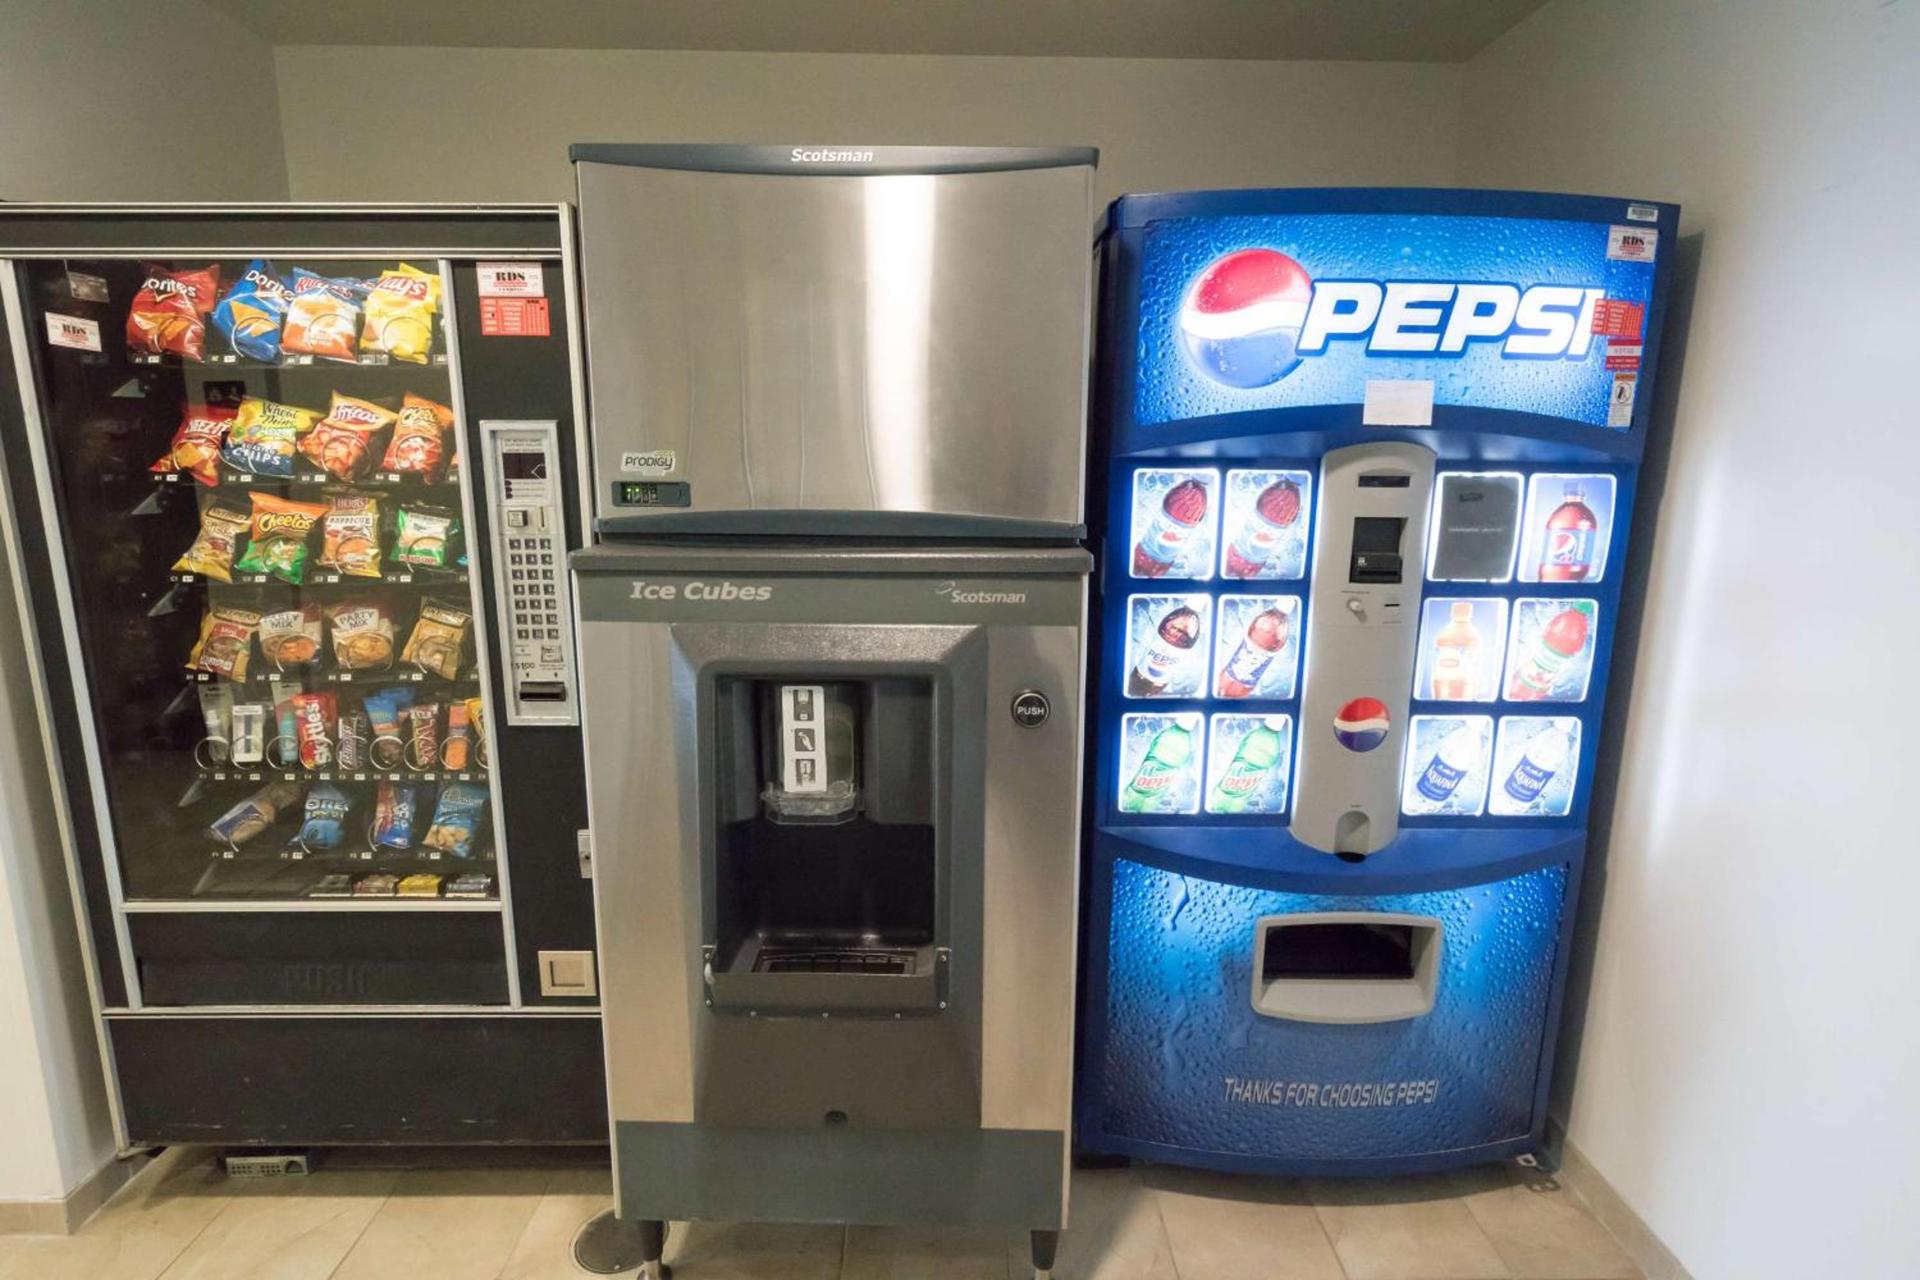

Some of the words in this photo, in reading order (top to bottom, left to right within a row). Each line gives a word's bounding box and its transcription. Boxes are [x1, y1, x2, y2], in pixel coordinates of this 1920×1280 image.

[791, 147, 874, 163] Scotsman
[1299, 281, 1607, 356] PEPSI
[258, 511, 315, 533] Cheetos
[629, 581, 677, 600] Ice
[684, 581, 773, 601] Cubes
[951, 590, 1026, 603] Scotsman
[339, 609, 375, 625] PARTY
[1017, 706, 1045, 716] PUSH
[1225, 1078, 1284, 1105] THANKS
[1285, 1083, 1318, 1106] FOR
[1320, 1083, 1393, 1108] CHOOSING
[1396, 1079, 1438, 1106] PEPSI
